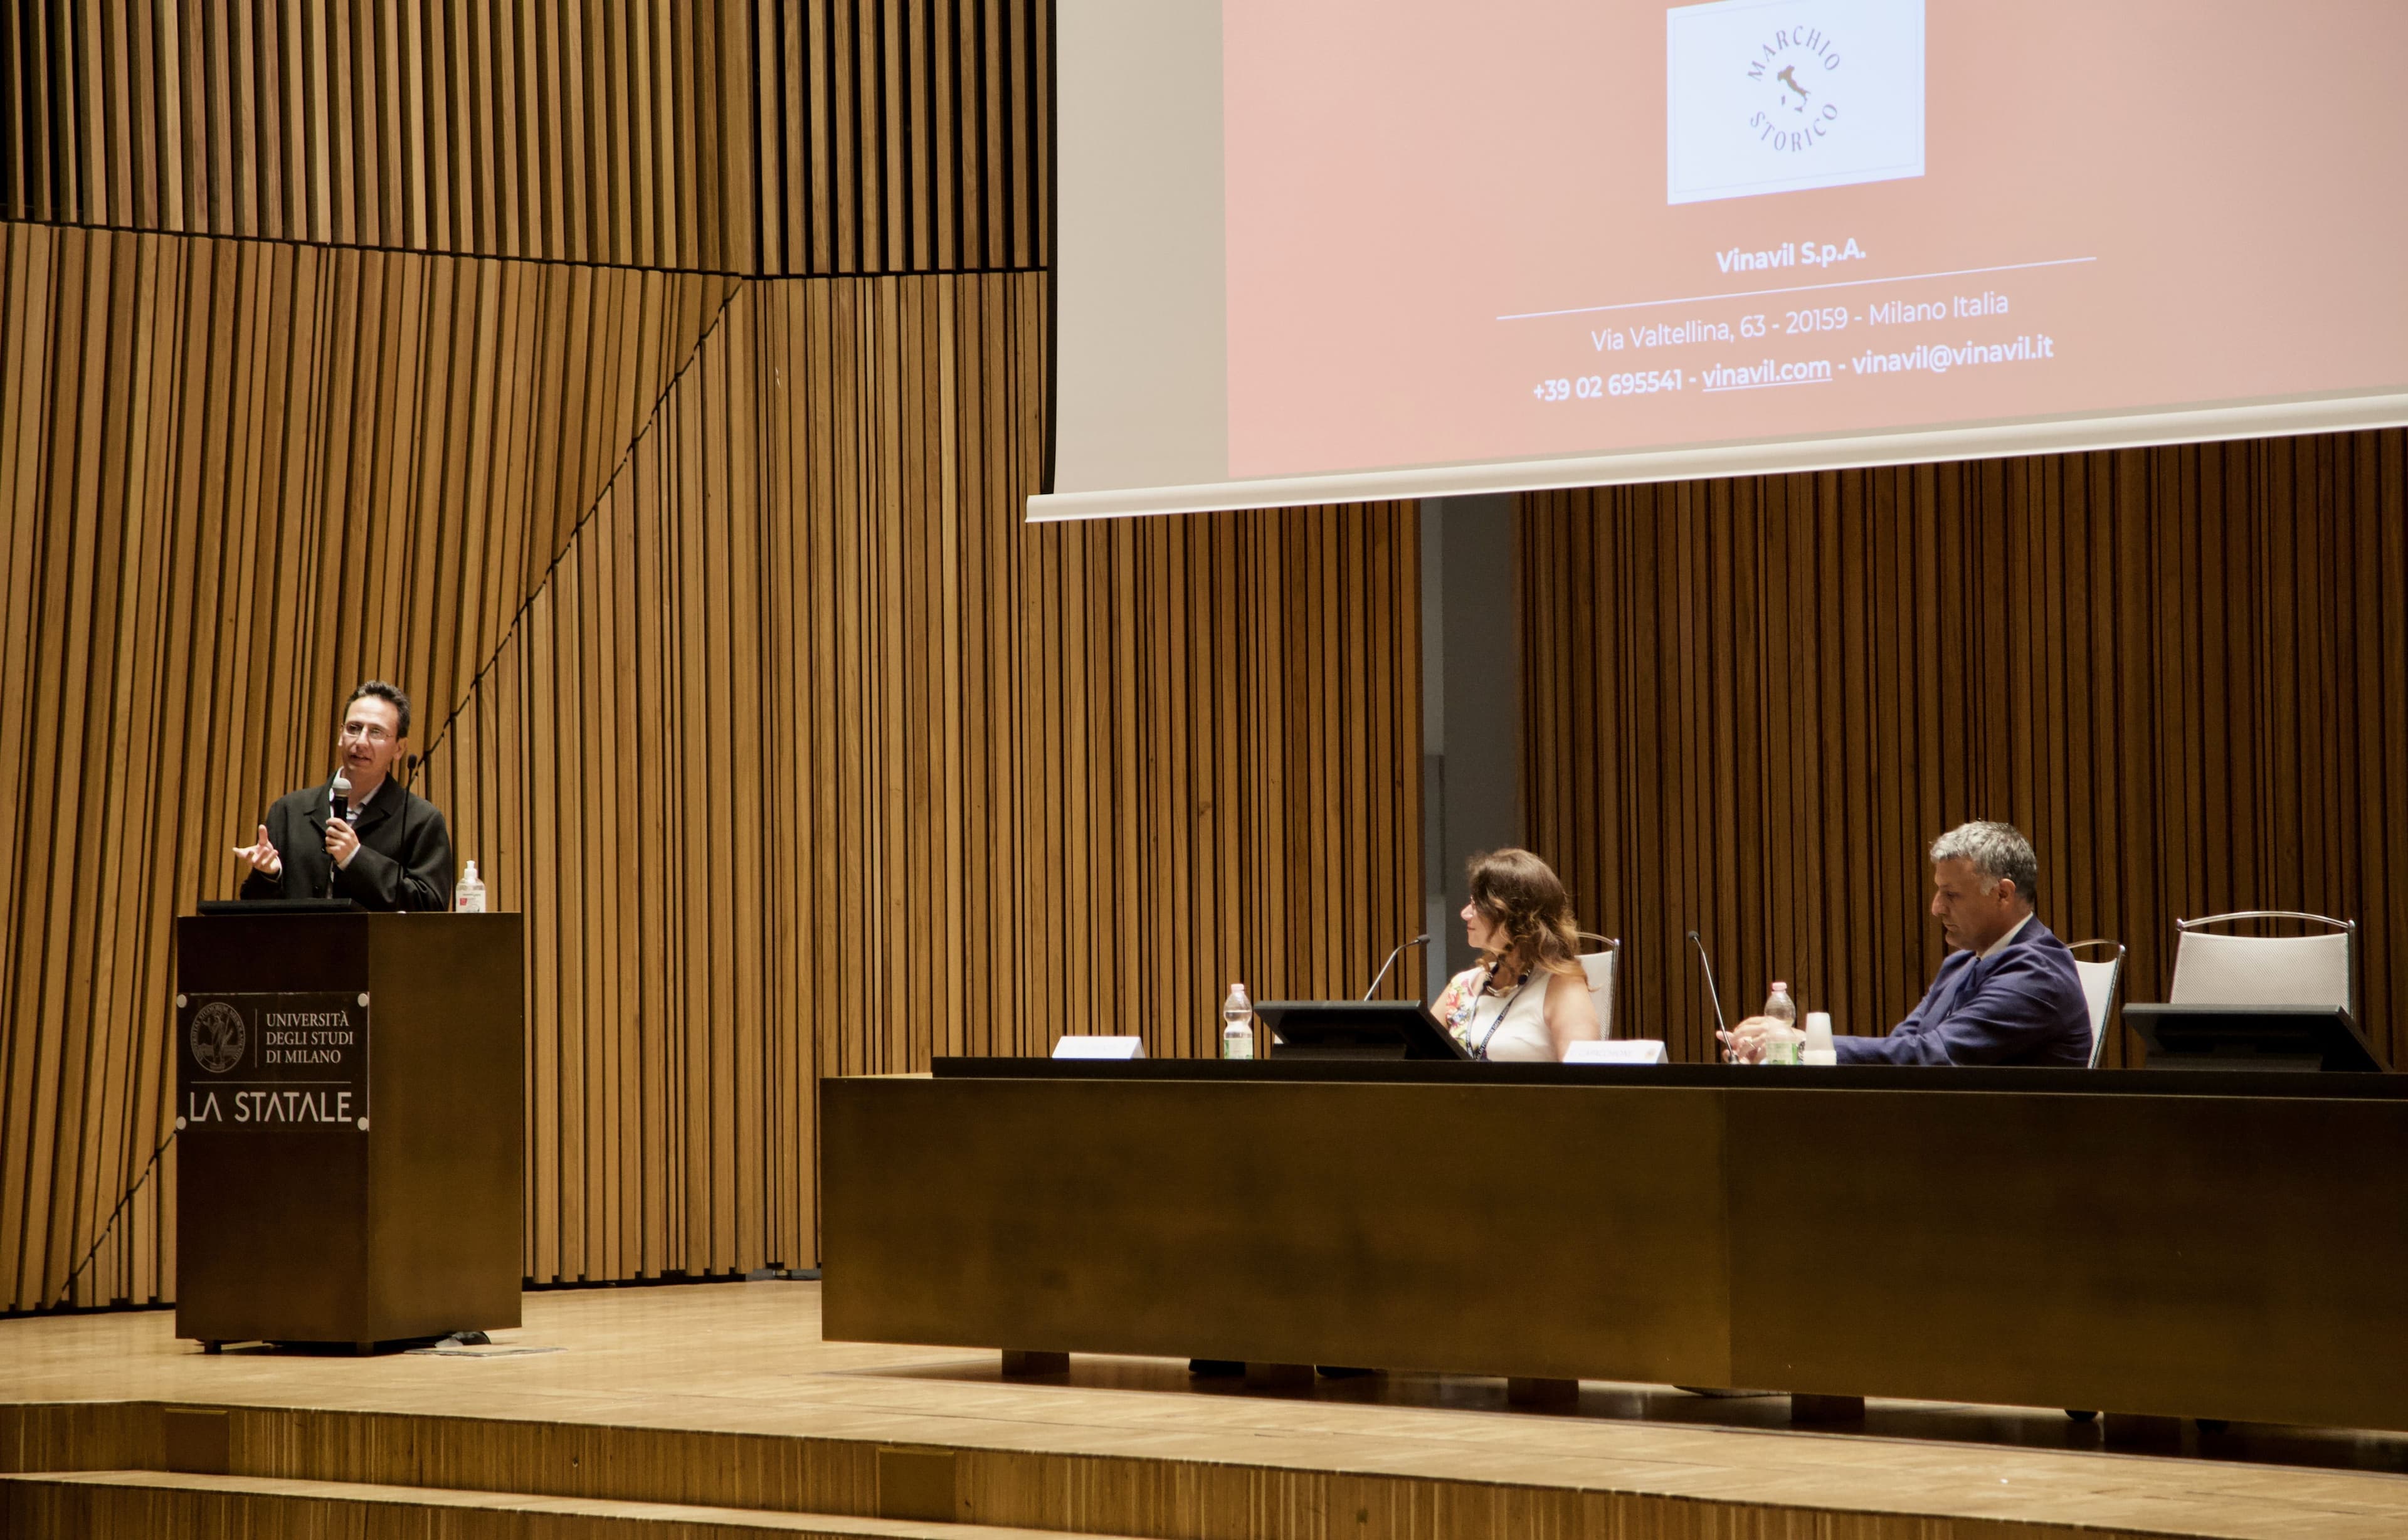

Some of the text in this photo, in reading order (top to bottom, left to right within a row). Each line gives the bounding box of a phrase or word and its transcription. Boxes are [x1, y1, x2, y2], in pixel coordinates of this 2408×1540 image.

[1748, 25, 1840, 82] MARCHIO
[1750, 103, 1838, 152] STORICO
[1716, 238, 1866, 273] Vinavil S.p.A.
[1592, 329, 1625, 351] Via
[1630, 321, 1735, 348] Valtellina,
[1740, 315, 1766, 339] 63
[1787, 307, 1849, 335] 20159
[1869, 301, 1946, 327] Milano
[1953, 292, 2009, 318] Italia
[1533, 379, 1571, 402] +39
[1576, 376, 1603, 399] 02
[1608, 369, 1682, 397] 695541
[1703, 359, 1832, 389] vinavil.com
[1852, 334, 2054, 376] vinavil@vinavil.it
[266, 1011, 349, 1026] UNIVERSITÀ
[266, 1031, 354, 1045] DEGLI STUDI
[266, 1050, 341, 1063] DI MILANO
[190, 1091, 352, 1122] LA STATALE
